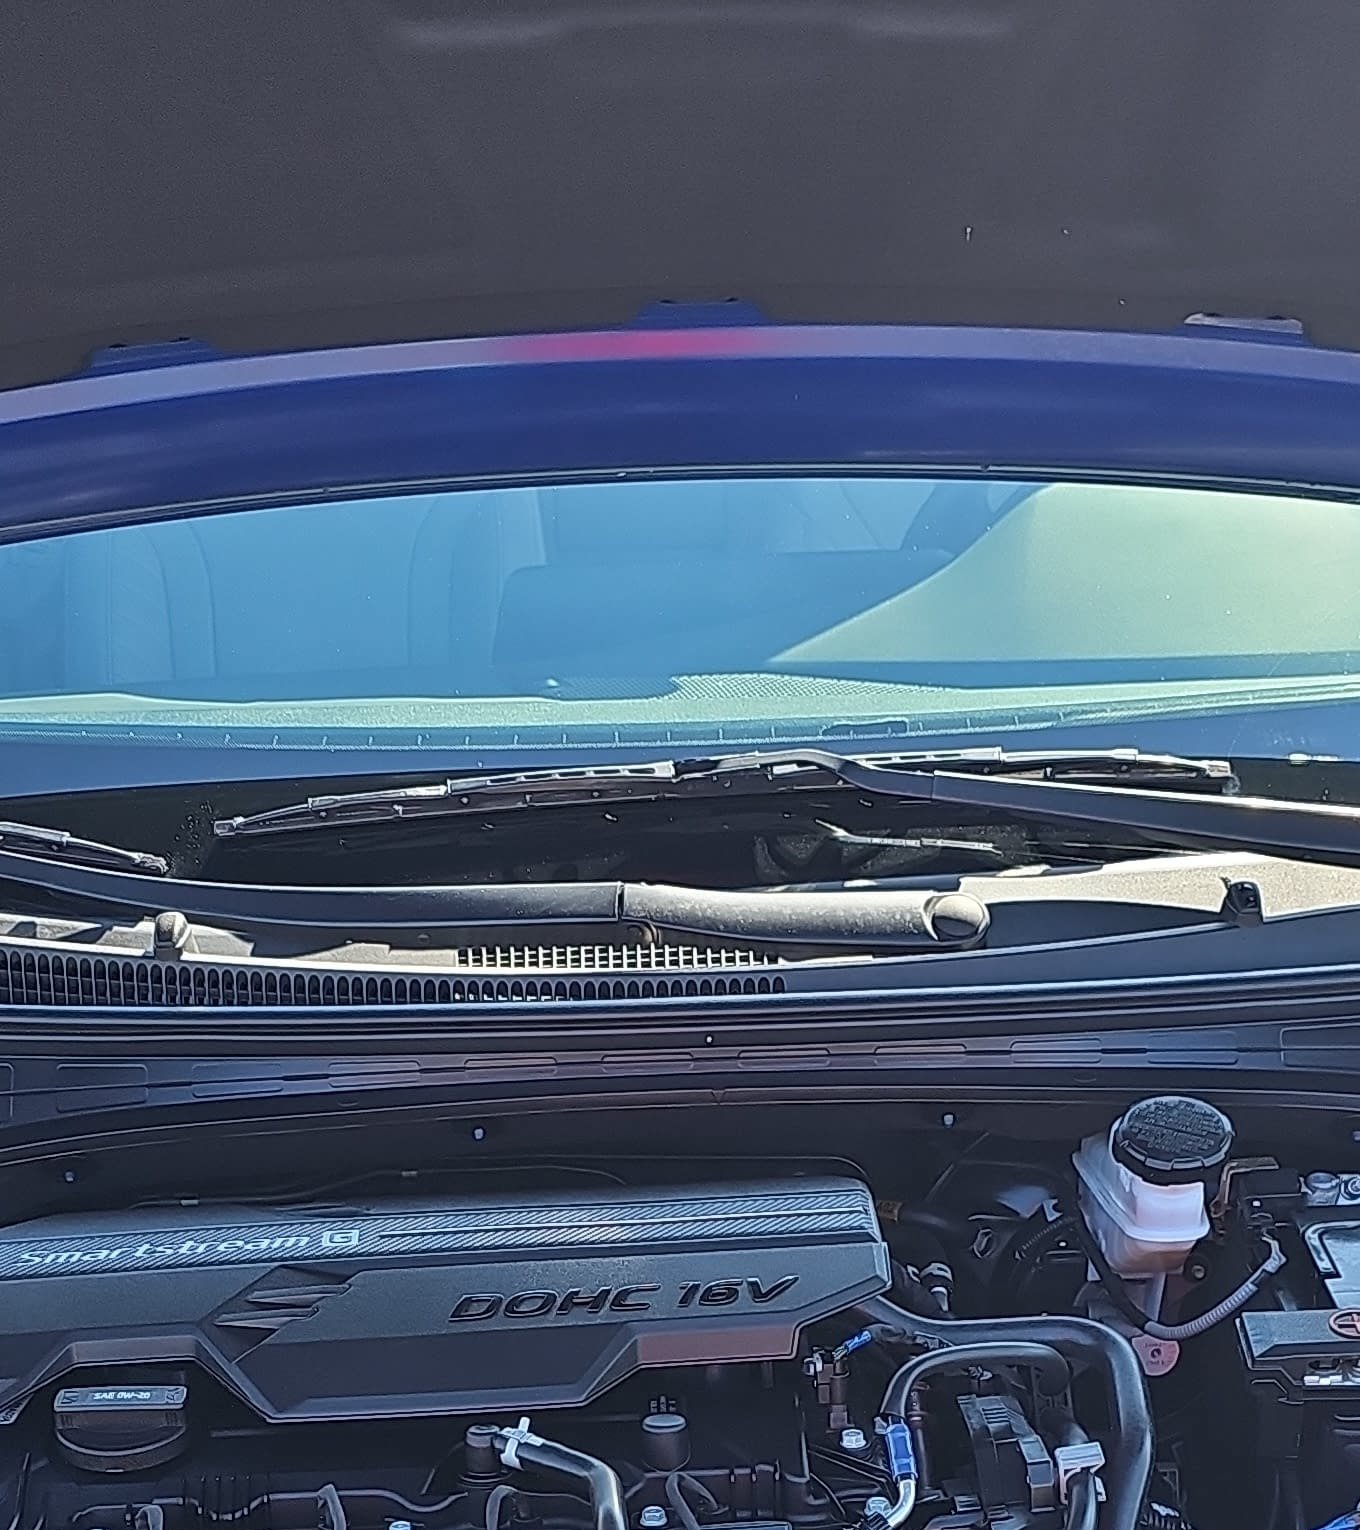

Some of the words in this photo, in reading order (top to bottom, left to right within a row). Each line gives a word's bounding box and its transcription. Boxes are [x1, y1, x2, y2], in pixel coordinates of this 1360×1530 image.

[17, 1236, 309, 1266] Smartstream
[448, 1283, 661, 1321] DOHC
[676, 1275, 800, 1308] 16V
